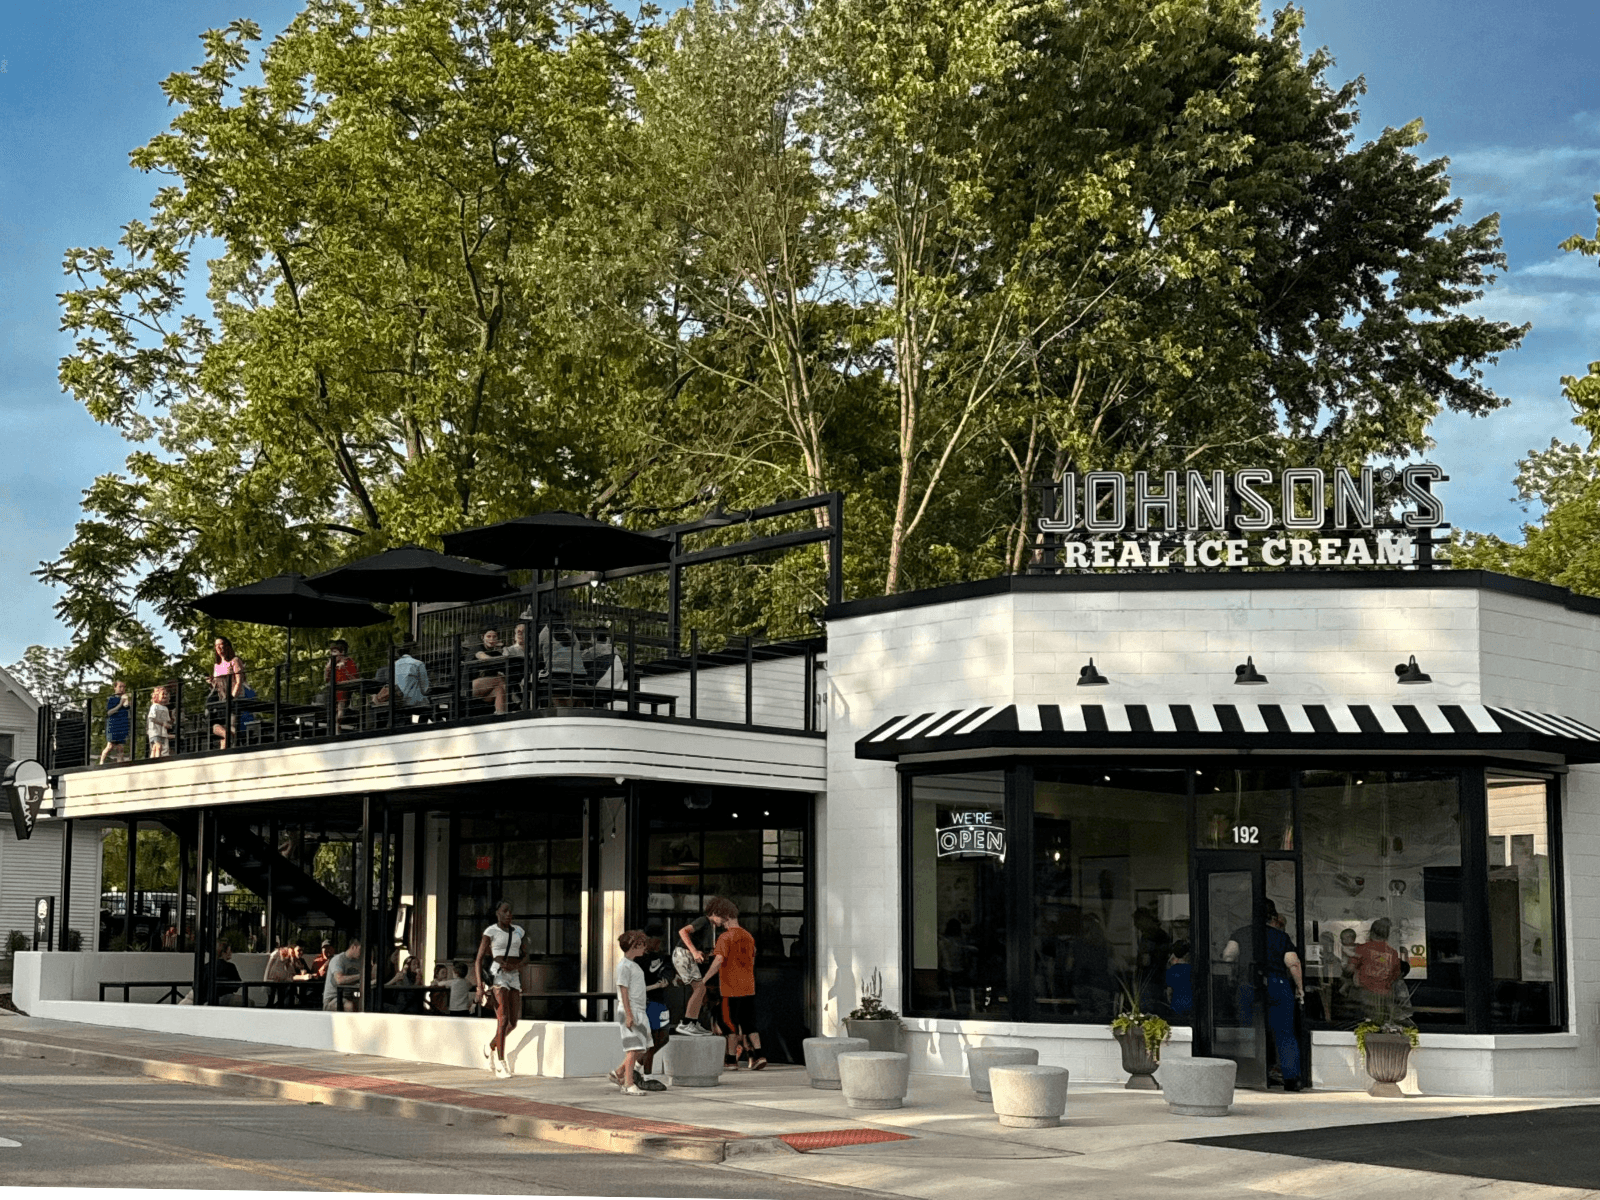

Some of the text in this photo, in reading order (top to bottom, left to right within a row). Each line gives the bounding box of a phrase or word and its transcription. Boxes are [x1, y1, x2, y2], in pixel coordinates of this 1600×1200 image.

[1038, 465, 1446, 534] JOHNSON'S
[1064, 536, 1417, 568] REAL ICE CREAM
[951, 812, 992, 824] WE'RE
[940, 830, 1003, 850] OPEN
[1232, 826, 1259, 843] 192
